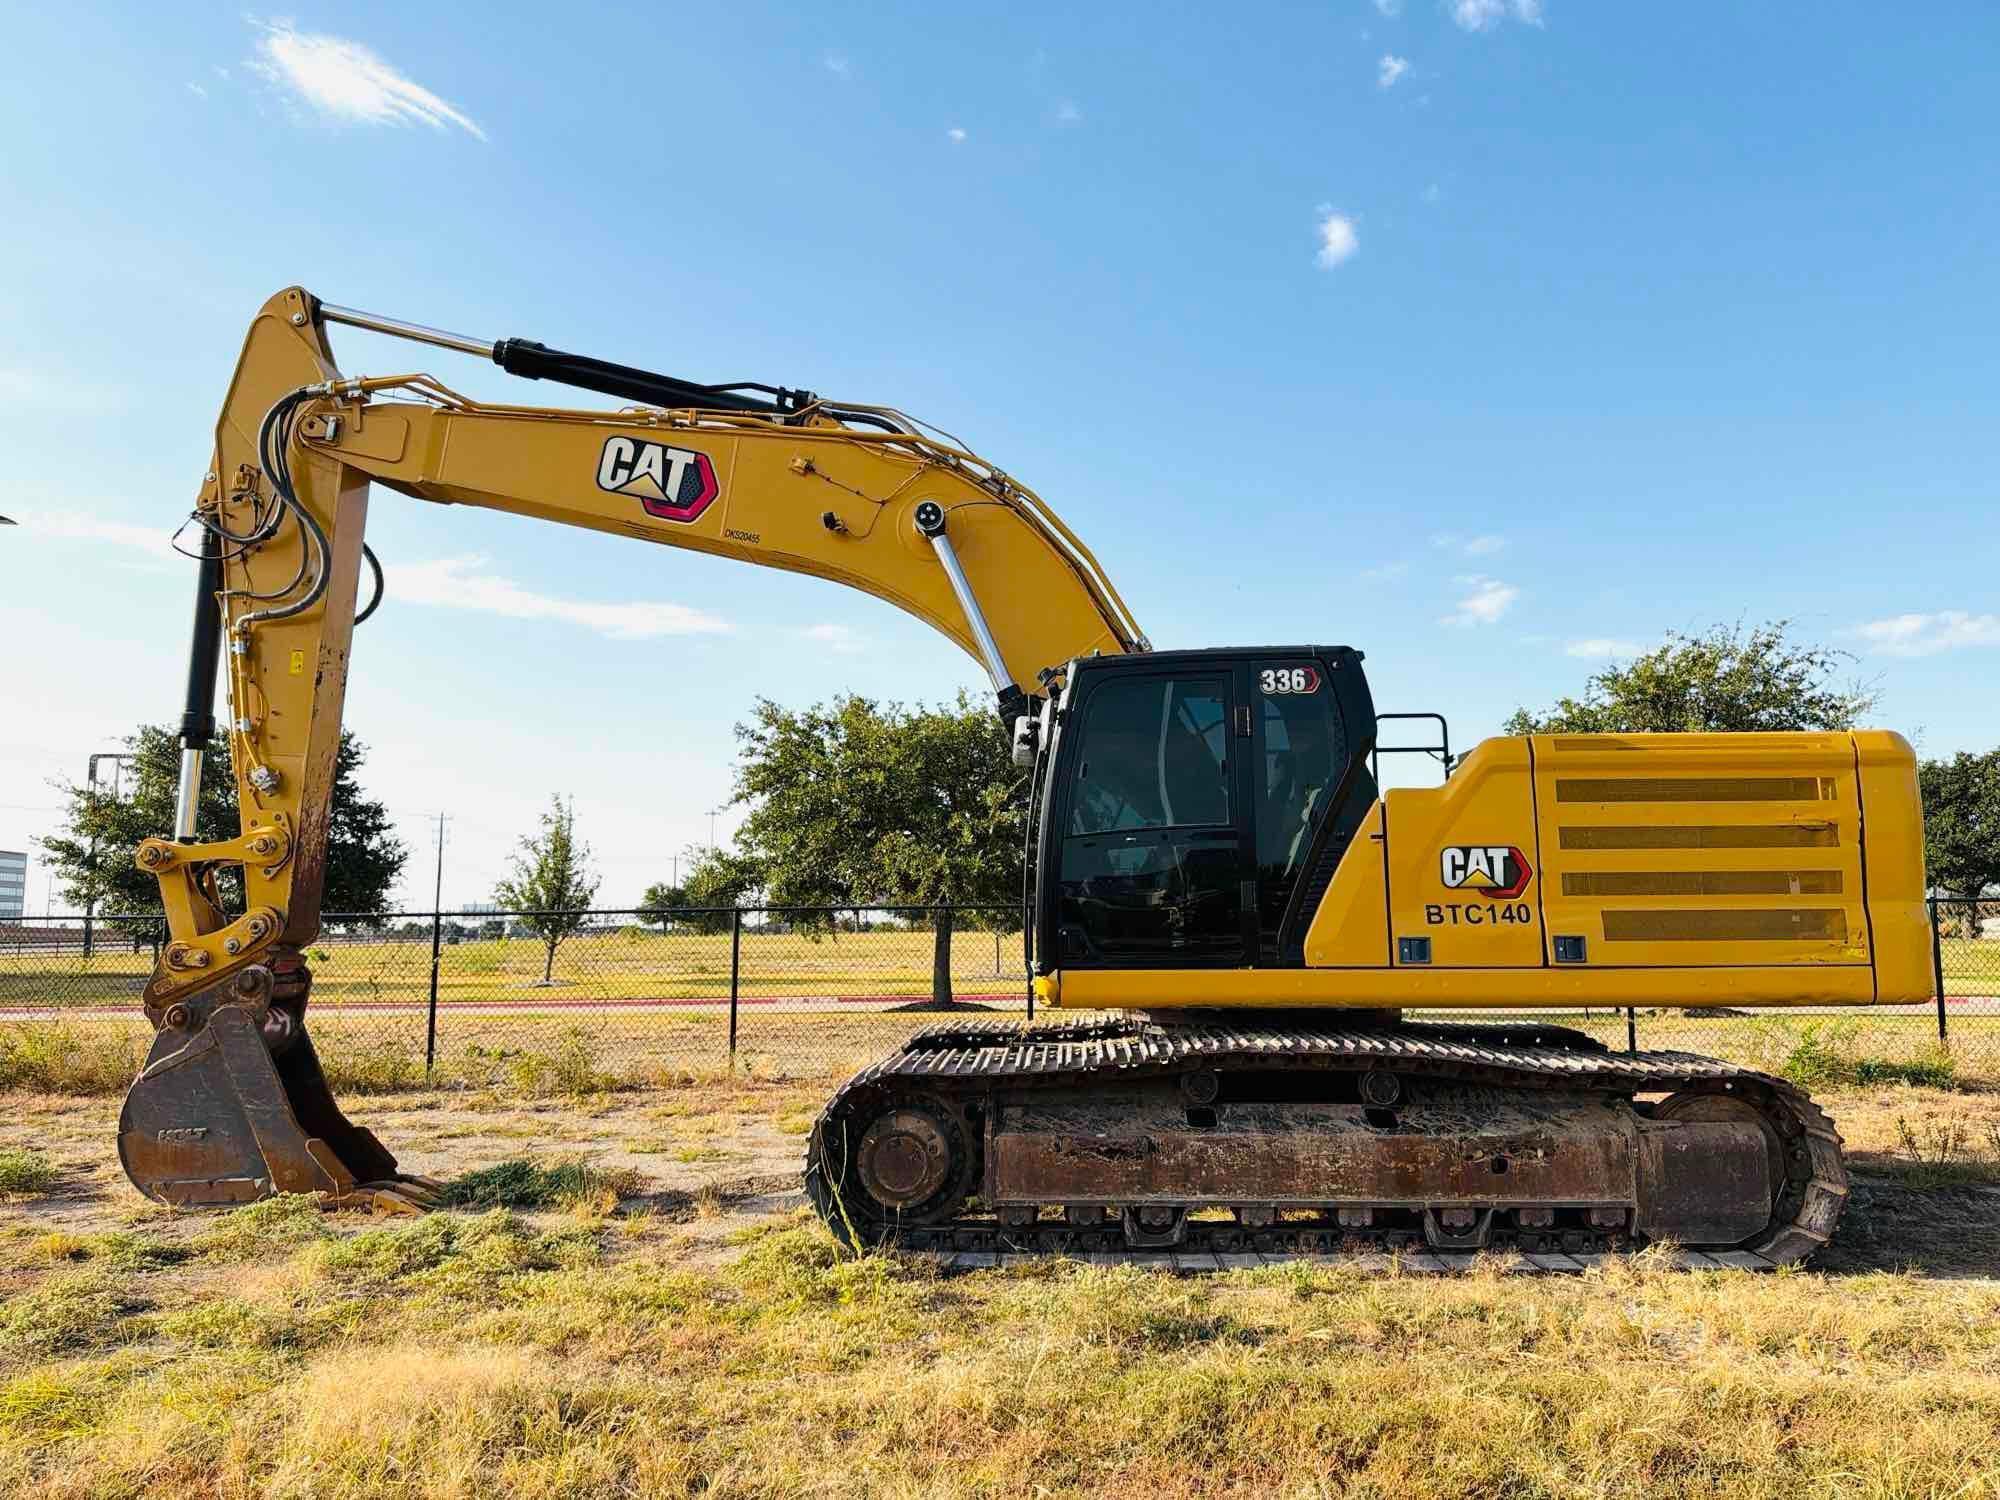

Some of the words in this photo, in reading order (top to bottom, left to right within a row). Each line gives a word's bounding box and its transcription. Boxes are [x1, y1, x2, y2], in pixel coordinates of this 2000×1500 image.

[599, 437, 695, 503] CAT
[1262, 669, 1306, 692] 336
[1442, 848, 1509, 888] CAT
[1426, 904, 1531, 925] BTC140
